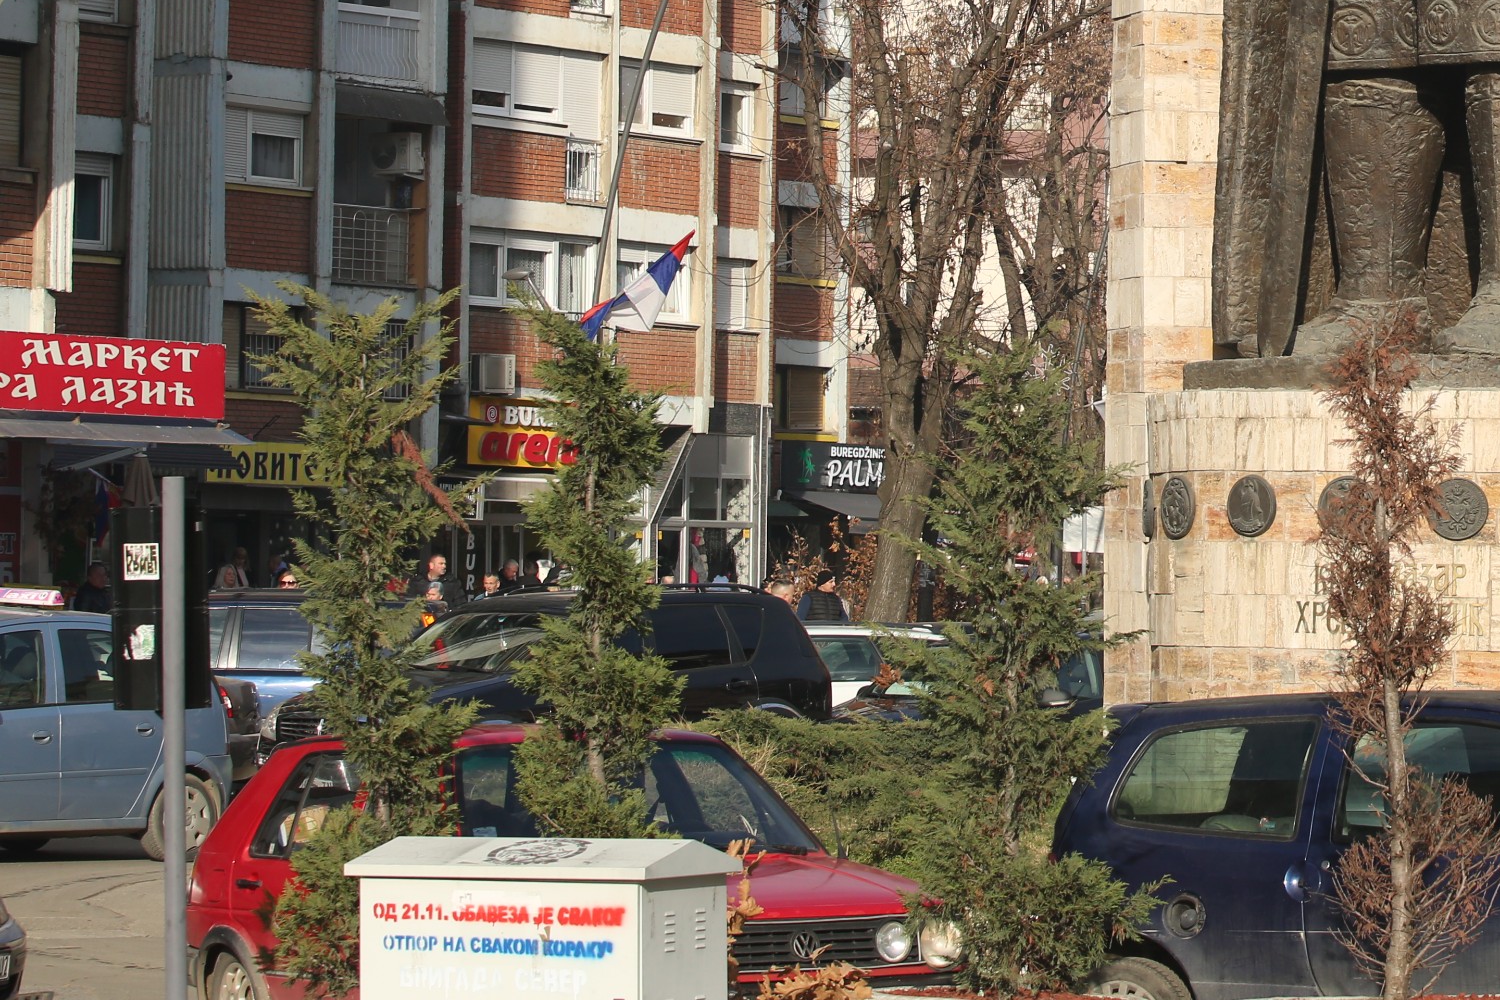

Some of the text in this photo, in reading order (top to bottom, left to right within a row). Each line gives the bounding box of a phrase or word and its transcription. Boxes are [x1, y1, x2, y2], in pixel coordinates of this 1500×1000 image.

[61, 376, 195, 408] ЛАЗИЋ
[373, 903, 398, 922] ОД
[401, 903, 449, 921] 21.11.
[383, 935, 438, 951] ОТПОР
[443, 936, 466, 952] НА
